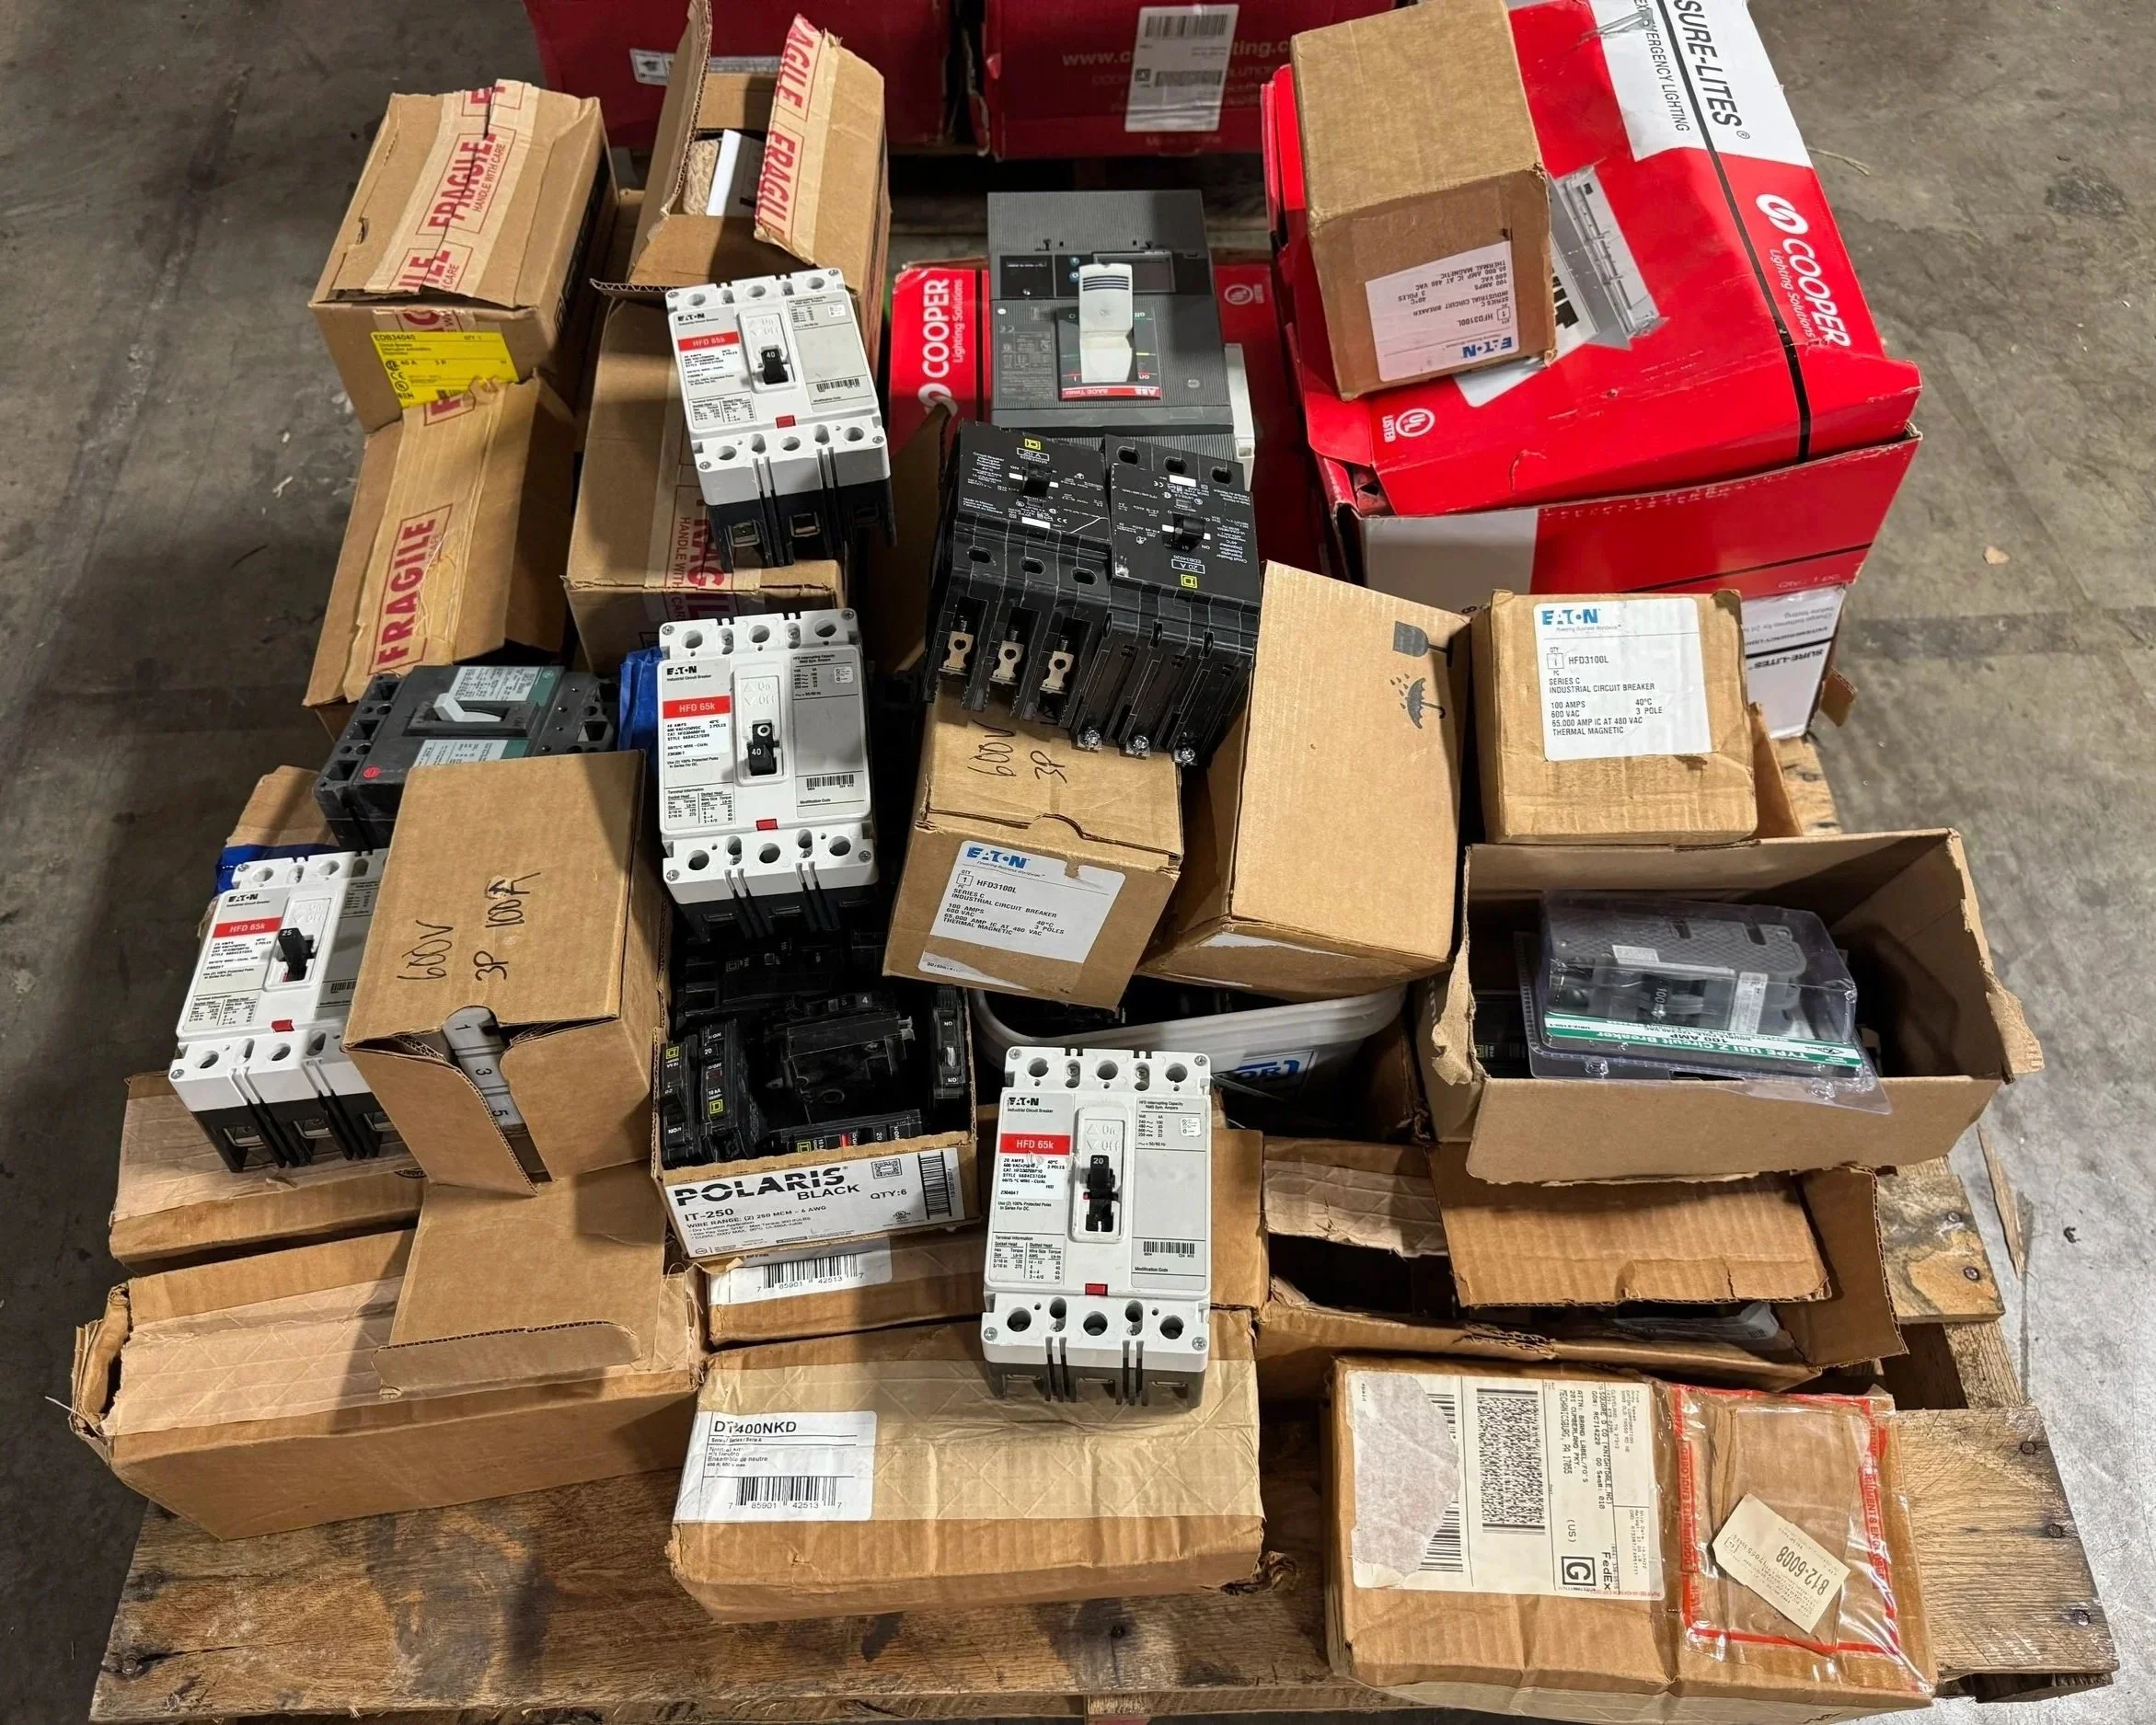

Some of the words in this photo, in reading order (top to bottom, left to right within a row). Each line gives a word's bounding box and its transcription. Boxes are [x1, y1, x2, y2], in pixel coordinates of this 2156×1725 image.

[1674, 0, 1744, 127] SURE-LITES
[1661, 76, 1691, 132] LIGHTING
[952, 280, 963, 321] Solutions
[1770, 247, 1795, 292] Lighting
[1786, 291, 1815, 340] Solutions
[1781, 239, 1850, 347] COOPER
[922, 279, 950, 378] COOPER
[952, 322, 966, 363] Lighting
[676, 516, 691, 560] HANDLE
[377, 519, 435, 664] FRAGILE
[1542, 608, 1597, 626] EATON
[1568, 656, 1608, 664] HFD3100L
[667, 665, 697, 675] EATON
[1550, 685, 1591, 694] INDUSTRIAL
[1623, 683, 1655, 691] BREAKER
[679, 704, 697, 712] HFD
[699, 702, 715, 711] 65k
[1552, 728, 1585, 736] THERMAL
[1587, 727, 1623, 735] MAGNETIC
[967, 845, 1027, 869] EATON
[953, 888, 978, 898] SERIES
[975, 879, 1017, 894] HFD3100L
[951, 891, 993, 906] INDUSTRIAL
[994, 901, 1022, 912] CIRCUIT
[1025, 906, 1056, 918] BREAKER
[963, 905, 985, 914] AMPS
[229, 925, 248, 933] HFD
[249, 923, 266, 931] 65k
[942, 916, 975, 928] THERMAL
[977, 923, 1012, 937] MAGNETIC
[971, 917, 986, 926] AMP
[1028, 928, 1042, 937] VAC
[1042, 926, 1065, 935] POLES
[397, 920, 454, 980] 600V
[475, 949, 509, 983] 3P
[1596, 1029, 1658, 1044] Breaker
[1662, 1036, 1712, 1051] Circuit
[1668, 1030, 1699, 1041] AMP
[1702, 1035, 1728, 1044] 100
[704, 1047, 713, 1055] 20
[1766, 1047, 1808, 1060] TYPE
[477, 1068, 492, 1076] 3
[492, 1109, 509, 1117] 5
[1016, 1139, 1035, 1149] HFD
[1038, 1140, 1054, 1149] 65k
[673, 1165, 847, 1208] POLARIS
[796, 1183, 860, 1202] BLACK
[870, 1188, 908, 1201] QTY:6
[685, 1207, 734, 1223] IT-250
[686, 1222, 709, 1230] WIRE
[709, 1217, 743, 1227] RANGE:
[772, 1210, 793, 1218] MCM
[1558, 1389, 1569, 1440] MECHANICSBURG,
[1562, 1443, 1569, 1453] PA
[1562, 1455, 1572, 1475] 17055
[1596, 1457, 1601, 1466] GO
[1566, 1519, 1576, 1542] (US)
[1565, 1561, 1591, 1581] G
[1600, 1551, 1612, 1590] FedEx
[1776, 1545, 1830, 1596] 812-6008
